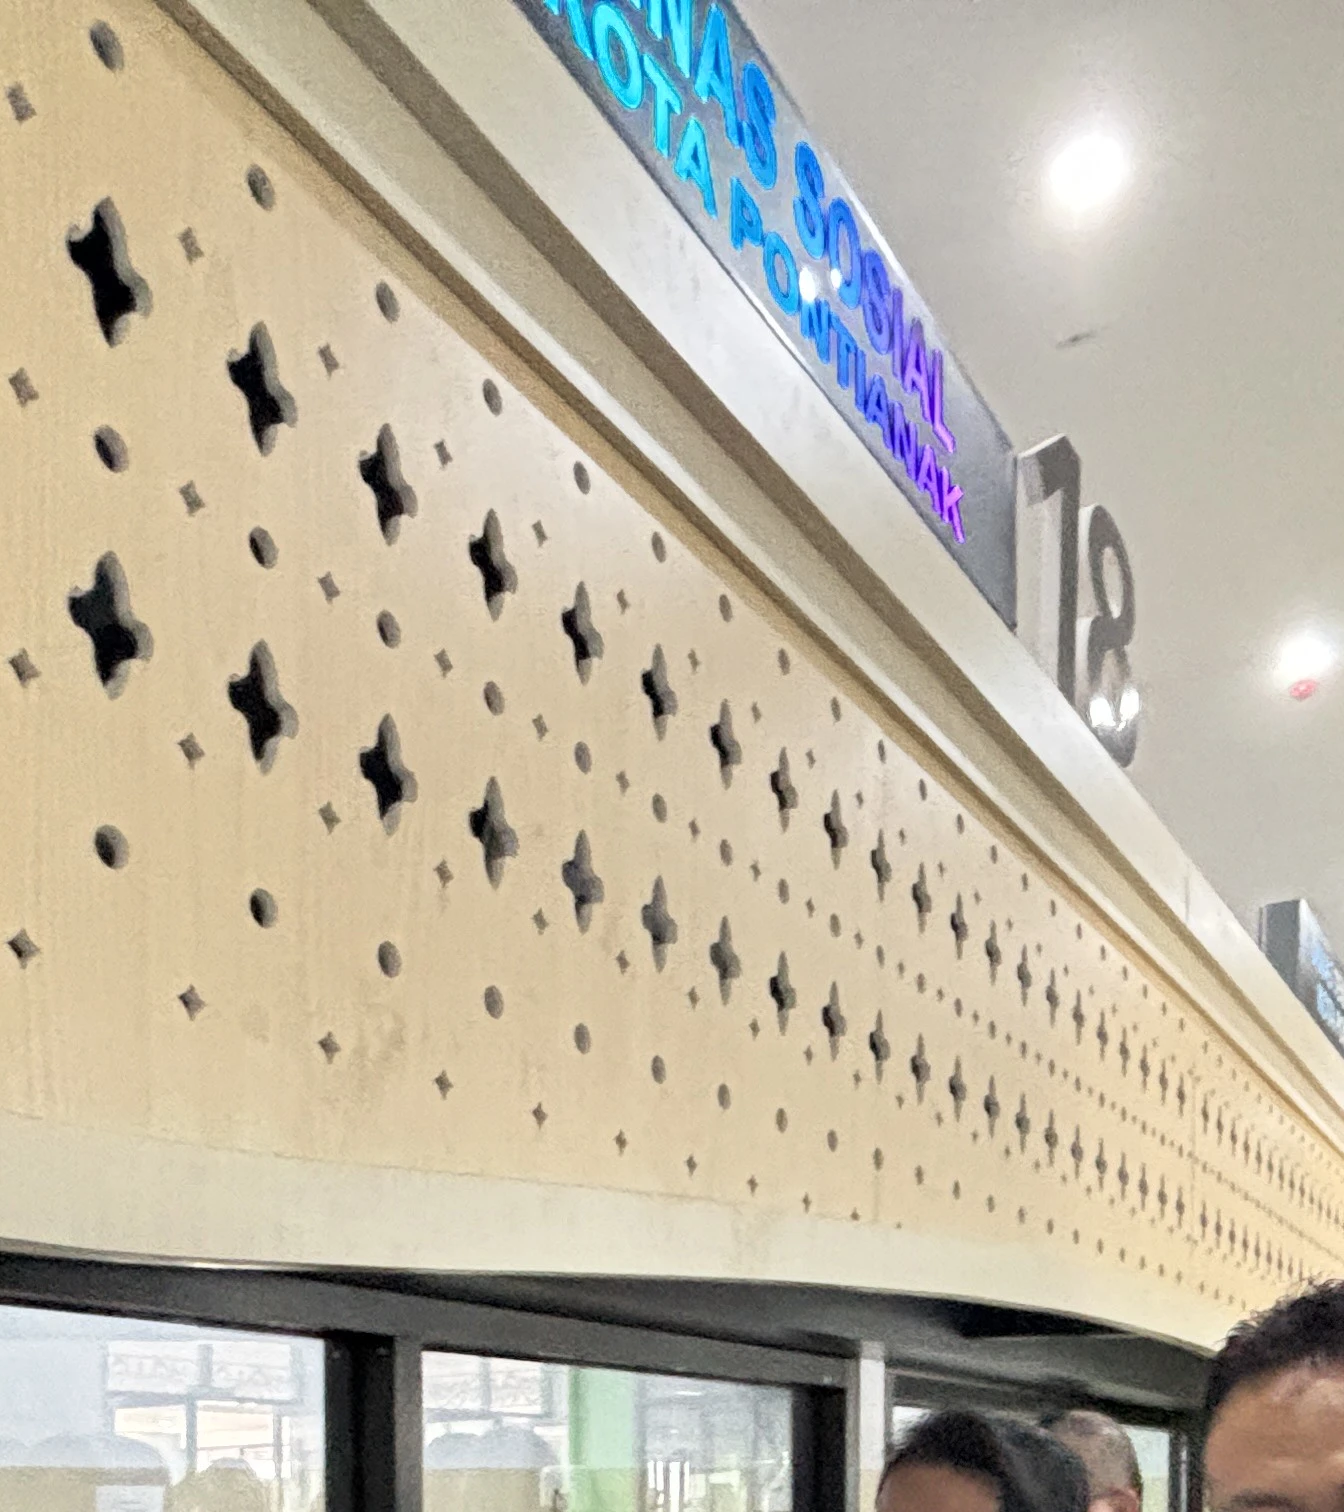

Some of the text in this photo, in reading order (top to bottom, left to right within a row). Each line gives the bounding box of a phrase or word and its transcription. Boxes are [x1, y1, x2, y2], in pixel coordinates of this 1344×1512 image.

[634, 0, 955, 462] NAS SOSIAL
[729, 177, 964, 543] PONTIANAK
[1019, 434, 1140, 768] 18
